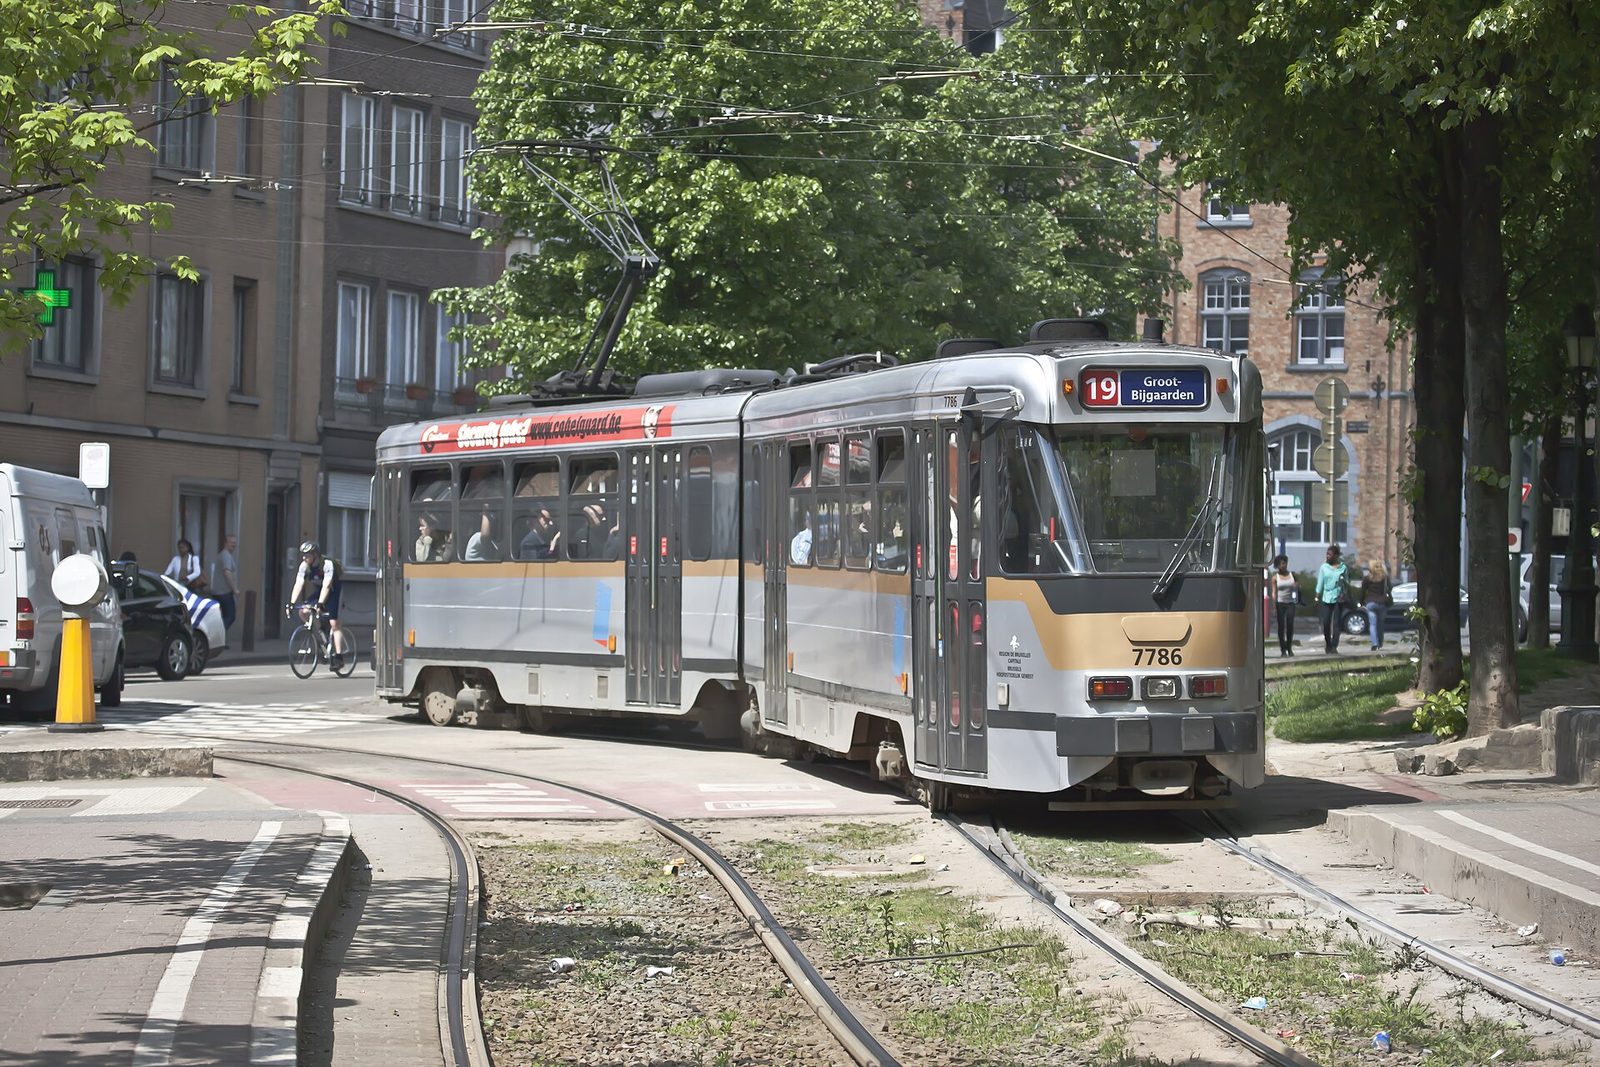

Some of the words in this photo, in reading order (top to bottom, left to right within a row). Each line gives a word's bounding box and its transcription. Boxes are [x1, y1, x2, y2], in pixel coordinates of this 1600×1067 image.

[1143, 376, 1182, 387] Groot-
[1085, 377, 1117, 400] 19
[943, 396, 958, 408] 7786
[1131, 390, 1194, 403] Bijgaarden
[1132, 648, 1182, 666] 7786
